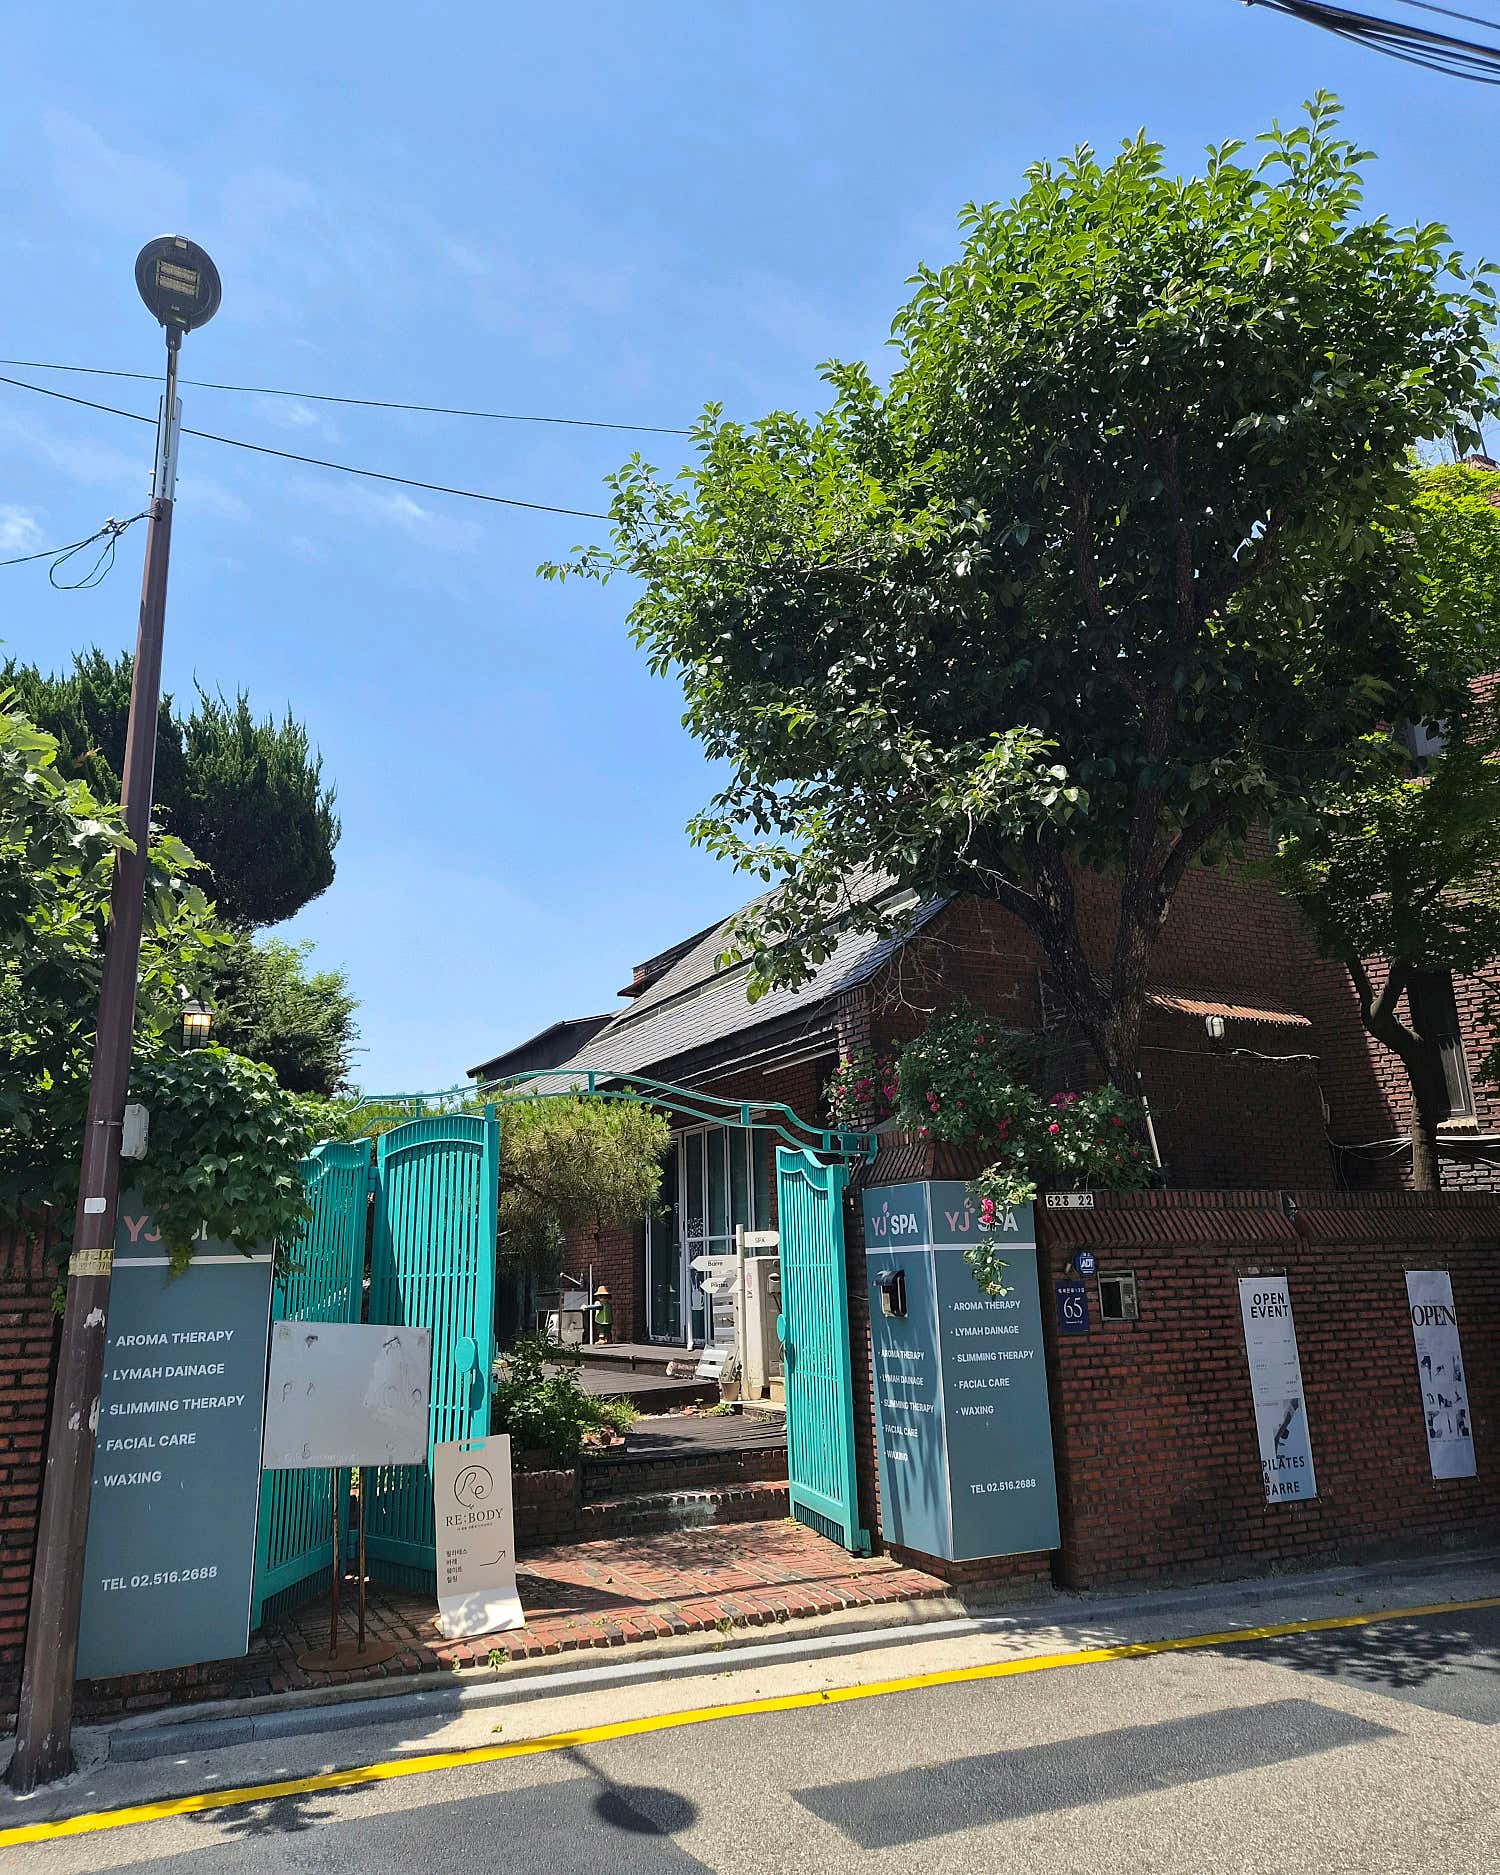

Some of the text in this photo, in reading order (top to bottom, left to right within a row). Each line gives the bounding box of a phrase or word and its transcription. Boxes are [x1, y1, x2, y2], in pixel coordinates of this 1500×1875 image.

[1078, 1195, 1093, 1206] 22
[872, 1213, 919, 1236] YJ SPA
[944, 1210, 970, 1232] YJ
[1080, 1258, 1094, 1268] ADT
[953, 1300, 1021, 1311] AROMA THERAPY
[1253, 1292, 1285, 1306] OPEN
[1063, 1296, 1083, 1319] 65
[1250, 1304, 1289, 1319] EVENT
[1411, 1304, 1457, 1327] OPEN
[116, 1330, 234, 1347] AROMA THERAPY
[955, 1325, 1020, 1337] LYMAH DAINAGE
[880, 1349, 925, 1361] AROMA THERAPY
[957, 1350, 1034, 1363] SLIMMING THERAPY
[112, 1363, 225, 1381] LYMAH DAINAGE
[901, 1376, 924, 1386] DAINAGE
[958, 1377, 1010, 1389] FACIAL CARE
[109, 1395, 246, 1416] SLIMMING THERAPY
[883, 1399, 935, 1413] SLIMMING THERAPY
[961, 1405, 994, 1416] WAXING
[885, 1424, 918, 1438] FACIAL CARE
[106, 1433, 196, 1451] FACIAL CARE
[886, 1449, 909, 1461] WAXING
[1262, 1455, 1305, 1471] PILATES
[103, 1470, 162, 1487] WAXING
[1264, 1472, 1270, 1484] &
[970, 1478, 1036, 1495] TEL 02.516.2688
[1265, 1481, 1301, 1497] BARRE
[446, 1508, 504, 1527] RE:BODY
[101, 1565, 218, 1591] TEL 02.516.2688
